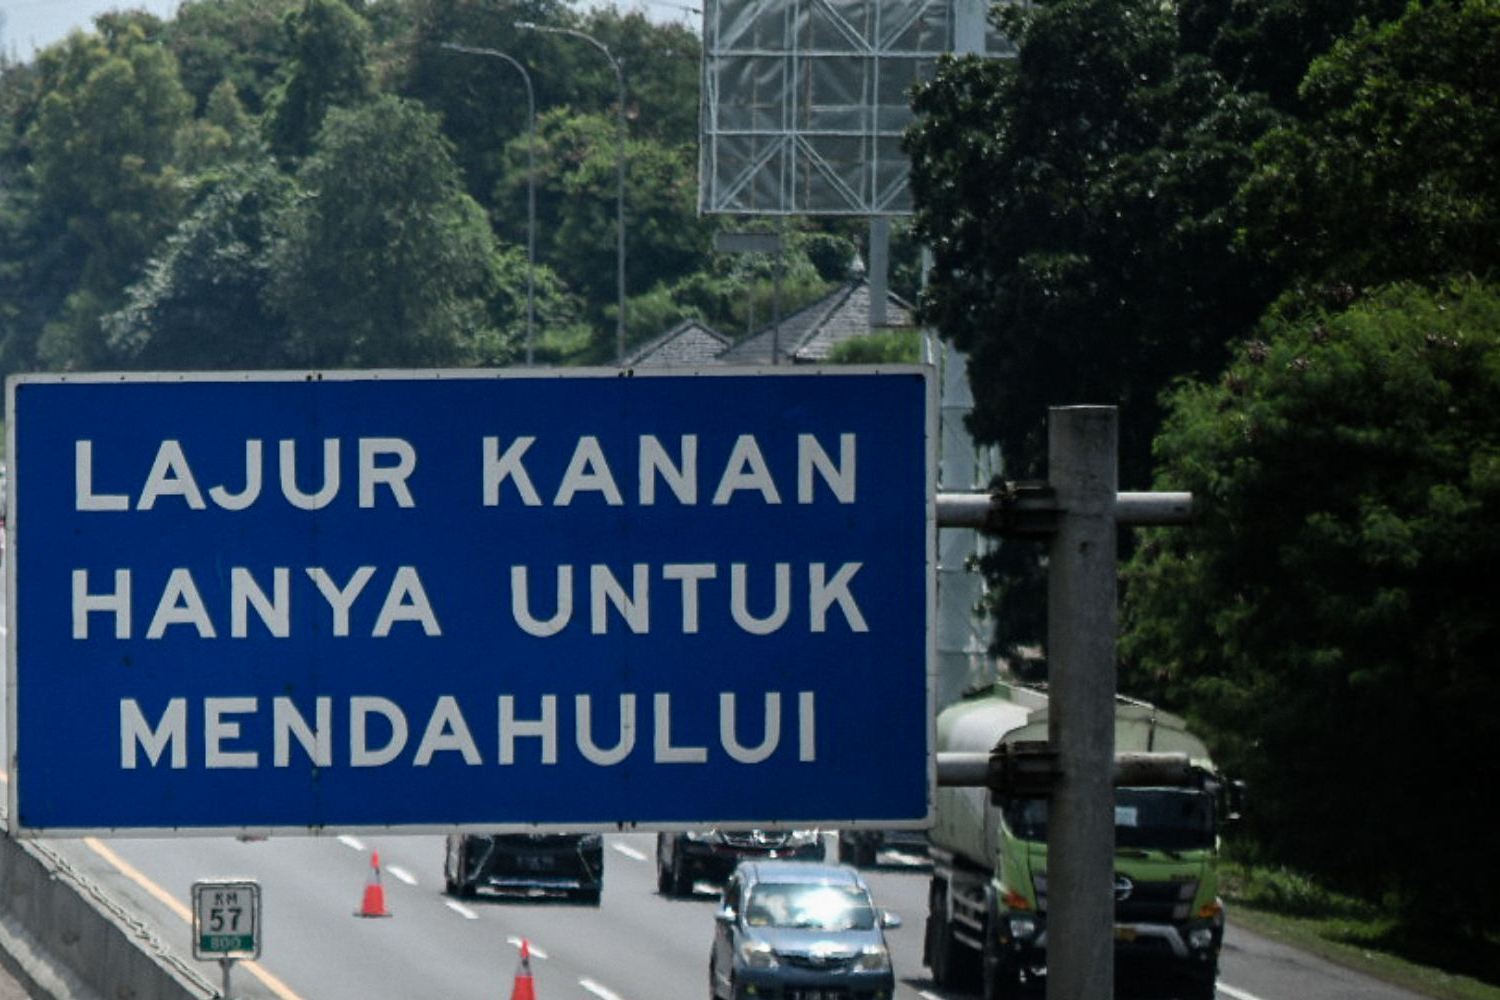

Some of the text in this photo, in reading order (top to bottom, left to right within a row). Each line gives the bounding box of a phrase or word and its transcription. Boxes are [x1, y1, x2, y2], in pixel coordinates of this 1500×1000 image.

[75, 433, 857, 511] LAJUR KANAN
[71, 562, 869, 640] HANYA UNTUK
[120, 691, 816, 770] MENDAHULUI
[210, 908, 243, 932] 57
[214, 892, 238, 906] KM
